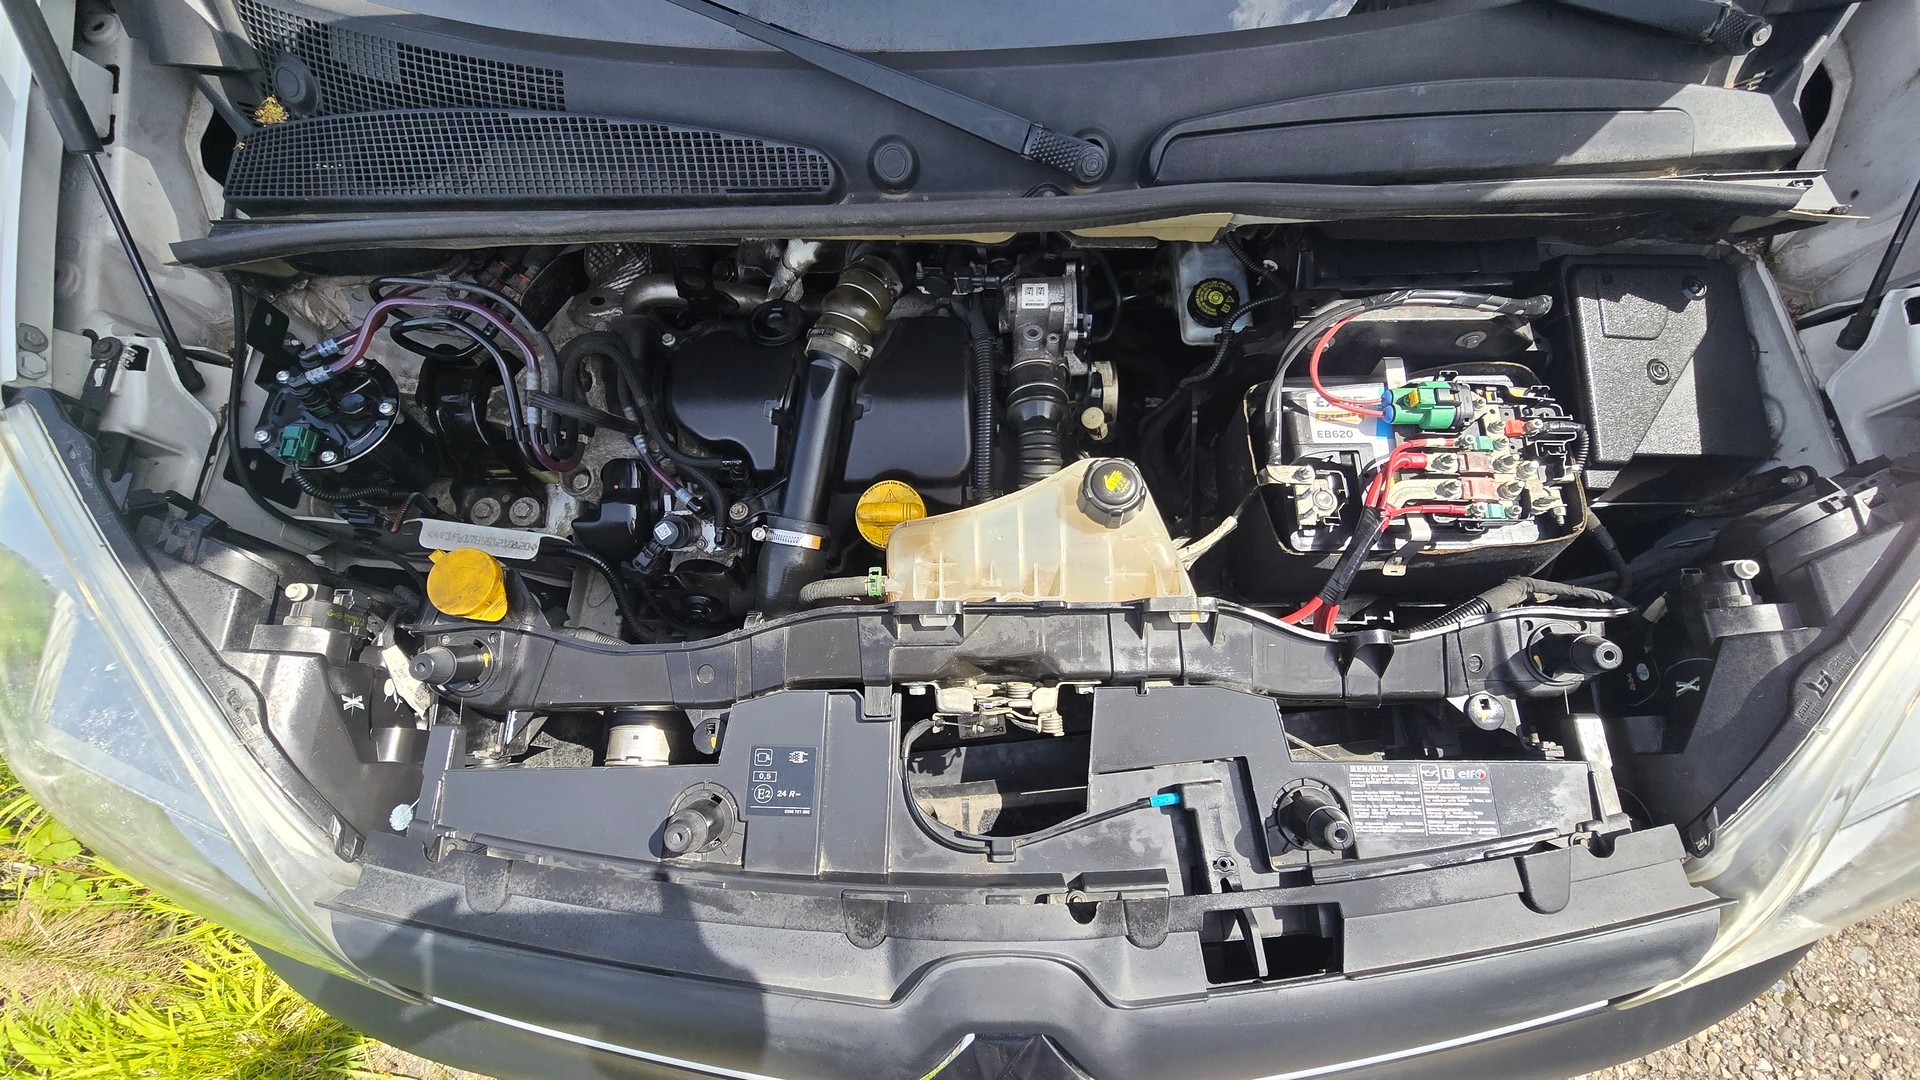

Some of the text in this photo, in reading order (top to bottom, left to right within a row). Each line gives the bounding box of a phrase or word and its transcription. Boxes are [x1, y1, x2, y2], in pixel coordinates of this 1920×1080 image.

[1316, 430, 1354, 439] EB620
[1349, 765, 1389, 773] RENAULT
[1457, 770, 1475, 779] elf
[757, 788, 771, 800] E2
[776, 790, 787, 798] 24
